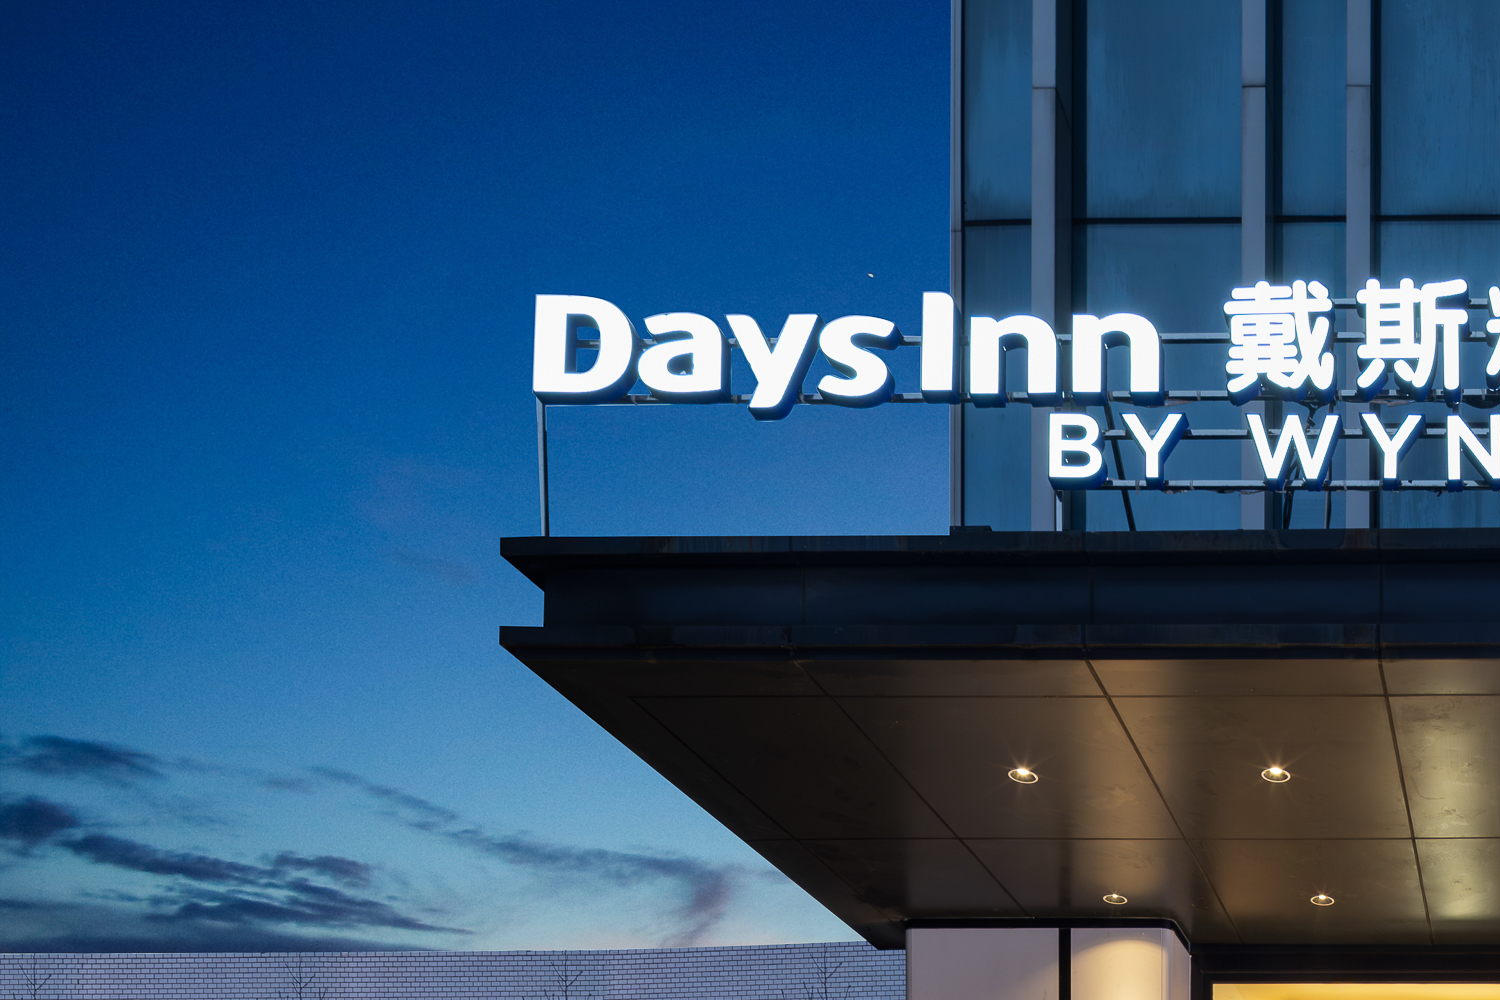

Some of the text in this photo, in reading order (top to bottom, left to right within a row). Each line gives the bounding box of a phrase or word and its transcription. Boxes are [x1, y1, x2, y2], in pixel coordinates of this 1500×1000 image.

[533, 291, 1161, 410] Days Inn
[1049, 413, 1182, 479] BY
